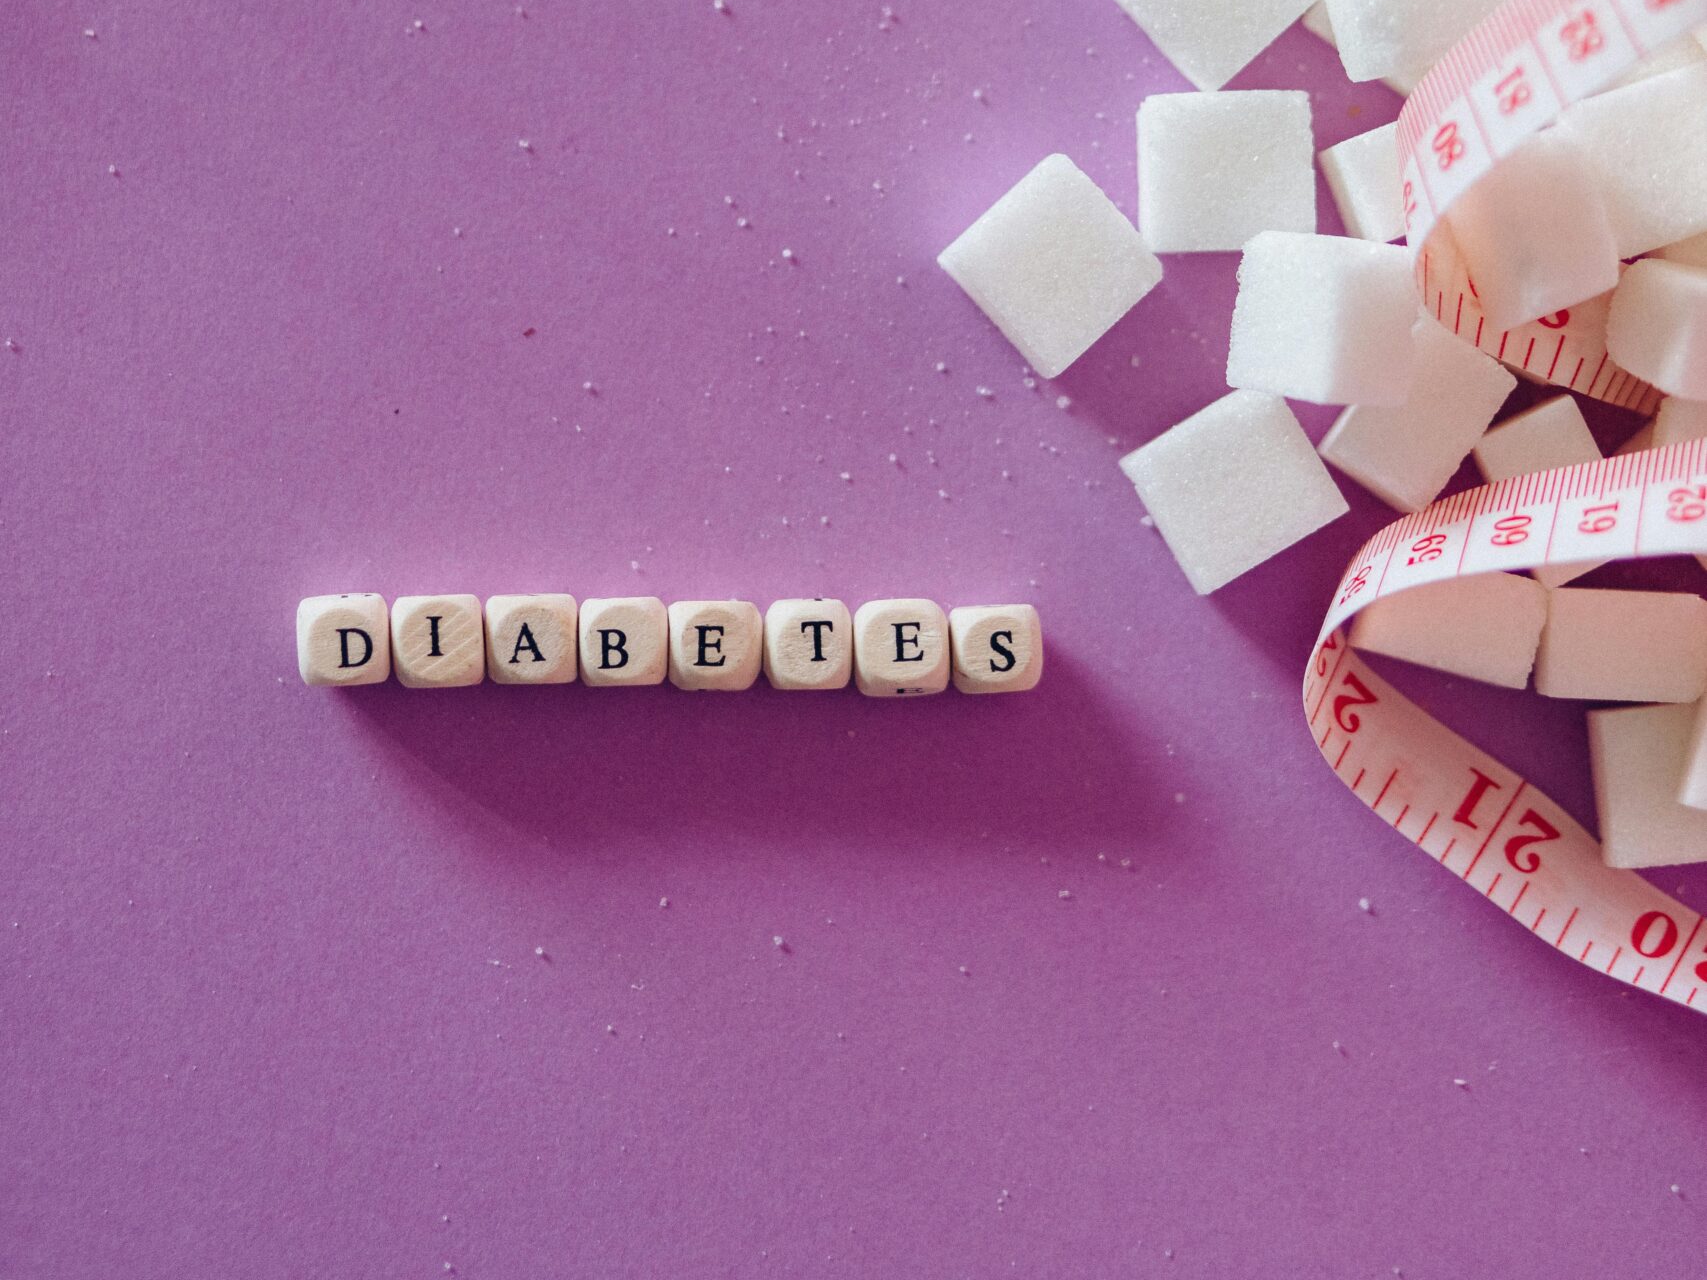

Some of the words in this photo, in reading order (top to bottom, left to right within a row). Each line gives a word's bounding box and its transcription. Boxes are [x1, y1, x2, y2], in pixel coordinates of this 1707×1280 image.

[1432, 122, 1465, 171] 80
[1495, 66, 1532, 116] 81
[1559, 9, 1606, 64] 82
[1339, 565, 1372, 606] 58
[1407, 534, 1448, 568] 59
[1490, 514, 1533, 547] 60
[1577, 500, 1622, 535] 61
[1665, 484, 1707, 523] 62
[334, 615, 1016, 673] DIABETES
